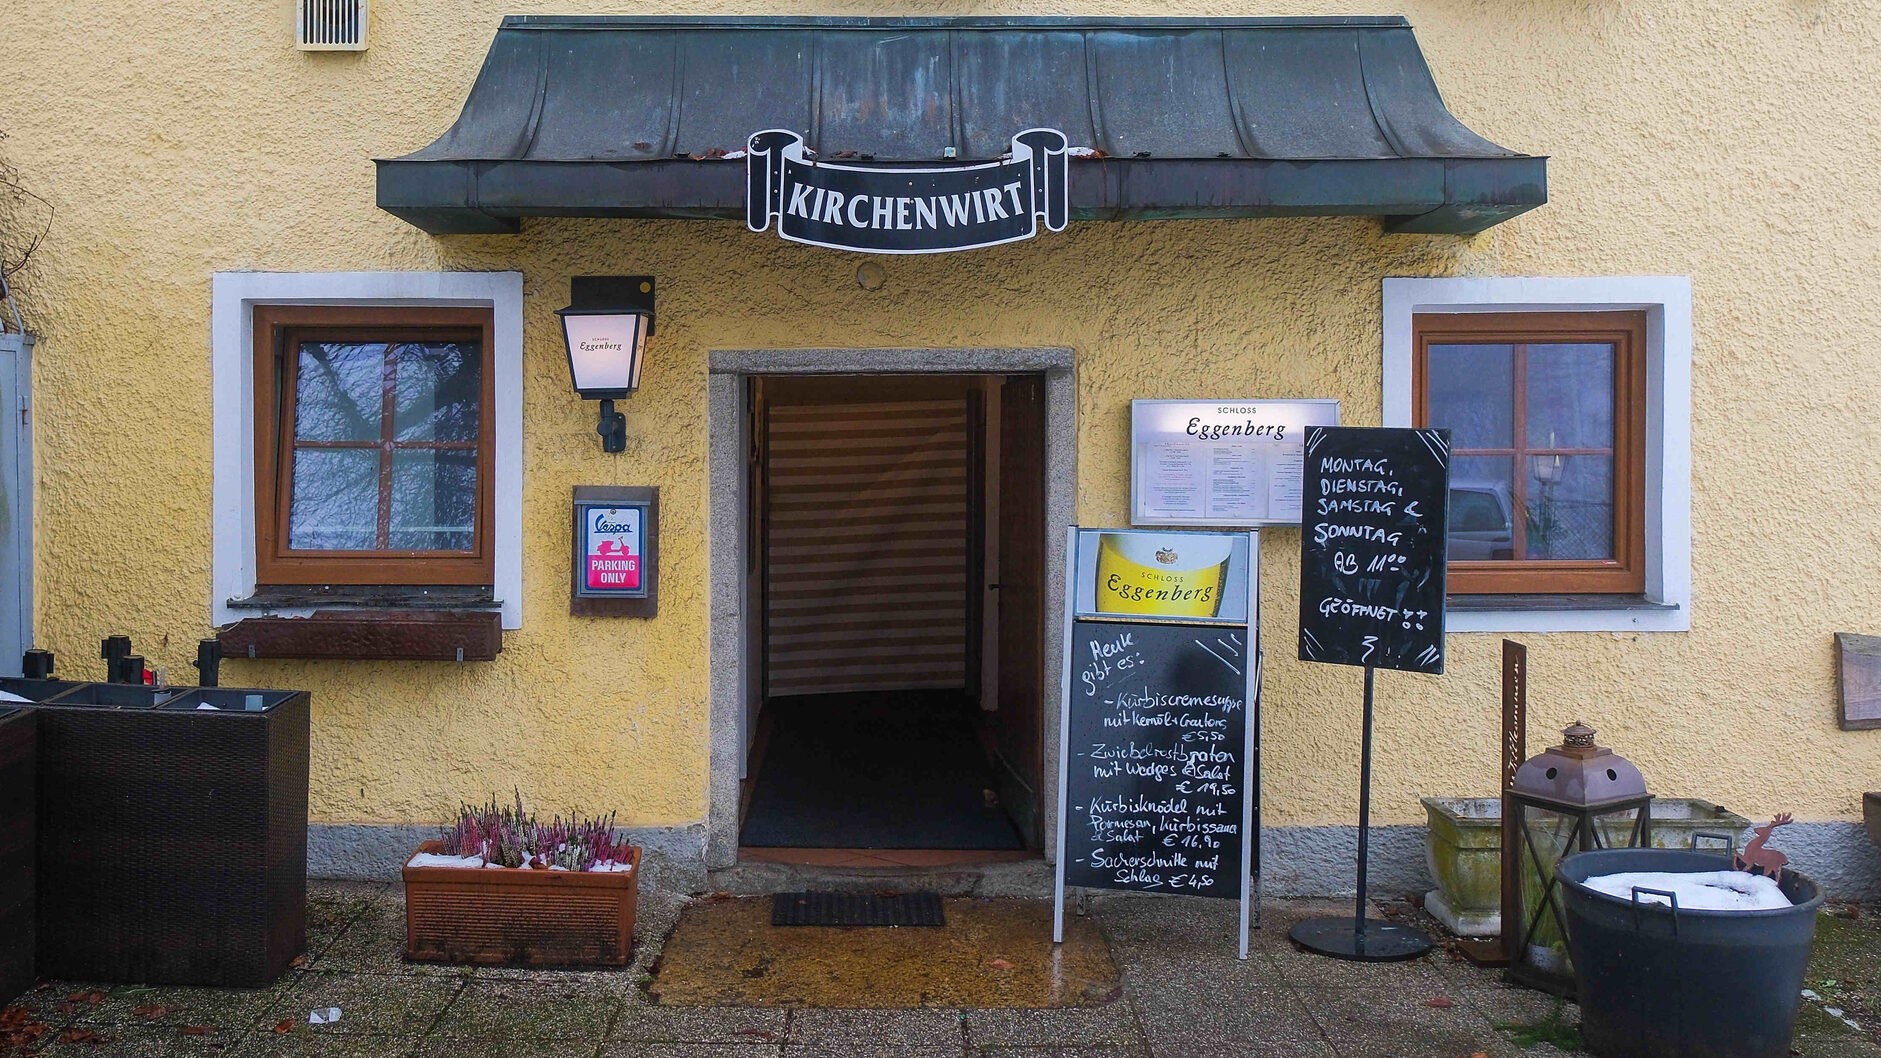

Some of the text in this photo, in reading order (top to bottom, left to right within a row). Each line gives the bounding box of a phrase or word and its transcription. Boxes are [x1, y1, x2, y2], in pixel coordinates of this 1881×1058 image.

[787, 181, 1025, 230] KIRCHENWIRT
[579, 341, 623, 351] Eggenberg
[1186, 417, 1286, 441] Eggenberg
[1320, 456, 1394, 476] MONTAG,
[1320, 479, 1403, 497] DIENSTAG,
[1317, 499, 1396, 517] SAMSTAG
[594, 514, 633, 535] Vespa
[1314, 523, 1403, 547] SONNTAG
[591, 560, 636, 571] PARKING
[1334, 551, 1359, 575] AB
[600, 572, 627, 584] ONLY
[1107, 573, 1214, 602] Eggenberg
[1141, 571, 1184, 583] SCHLOSS
[1319, 597, 1399, 622] GEÖFFNET
[1081, 652, 1145, 697] gibt es:
[1116, 685, 1243, 713] Kürbiscremesuppe
[1104, 710, 1130, 728] mit
[1093, 761, 1122, 778] mit
[1125, 761, 1177, 782] Wedges
[1089, 794, 1188, 814] Kürbisknödel
[1196, 802, 1228, 816] mit
[1086, 814, 1156, 835] Parmesan,
[1106, 828, 1145, 843] Salat
[1090, 848, 1188, 869] Sacherschnitte
[1194, 855, 1219, 870] mit
